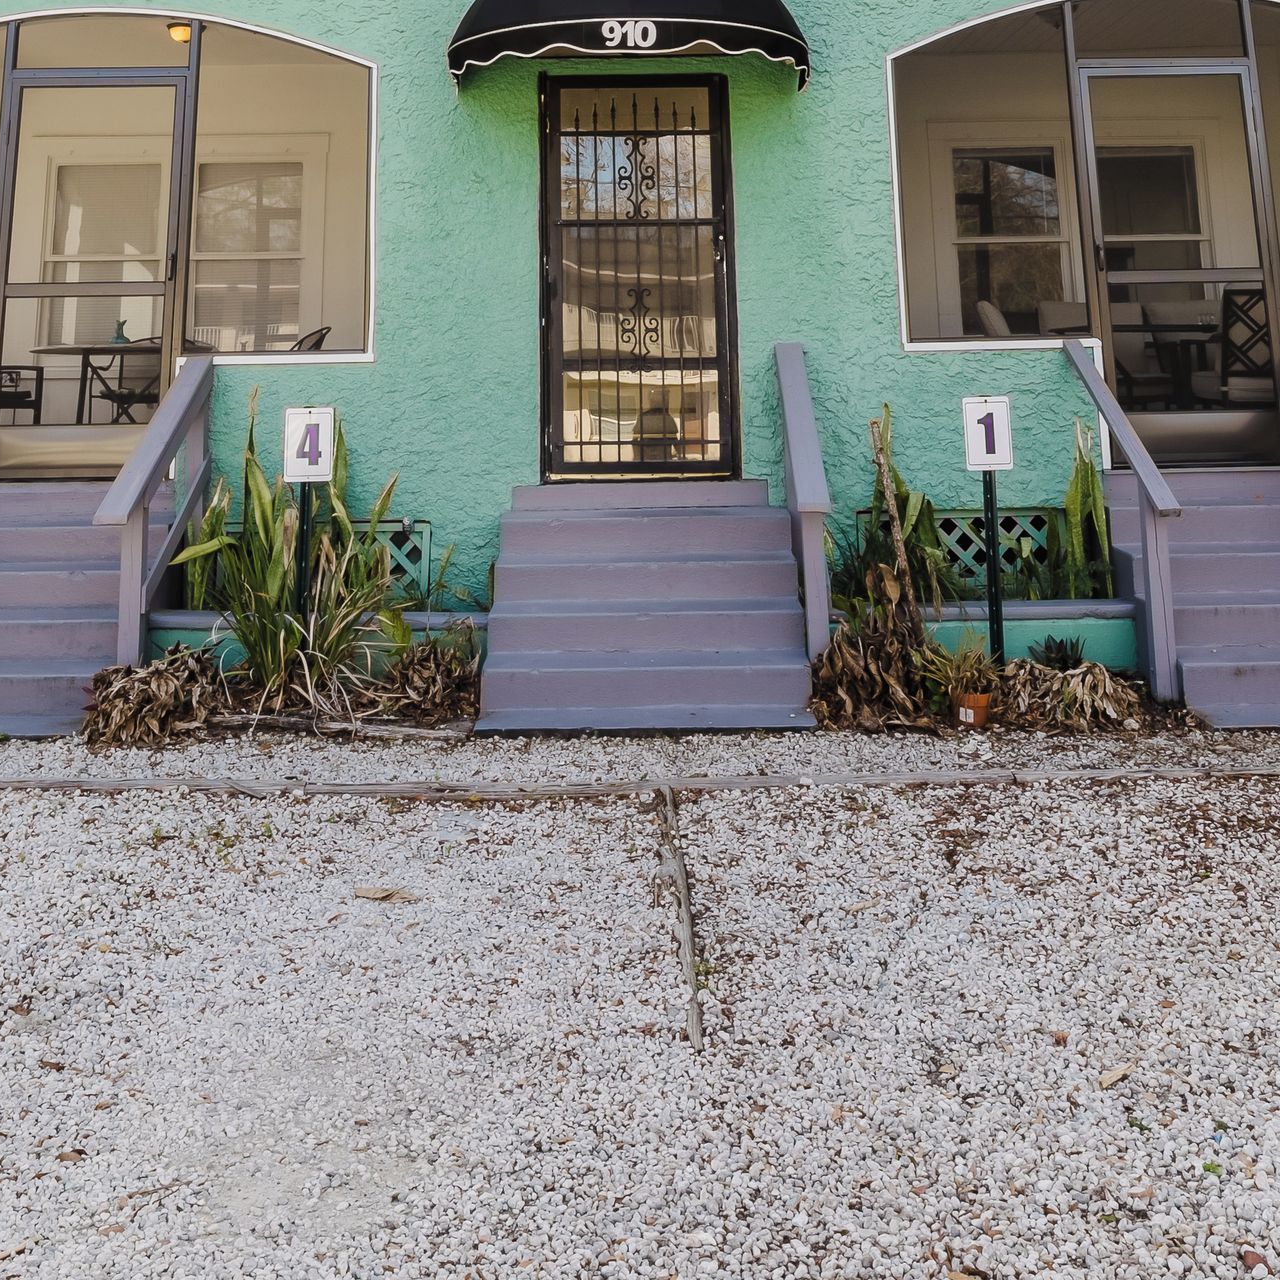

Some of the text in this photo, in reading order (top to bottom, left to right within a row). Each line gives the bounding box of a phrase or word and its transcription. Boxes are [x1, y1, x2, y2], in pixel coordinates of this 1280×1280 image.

[601, 20, 657, 48] 910
[295, 423, 322, 466] 4
[977, 412, 996, 455] 1
